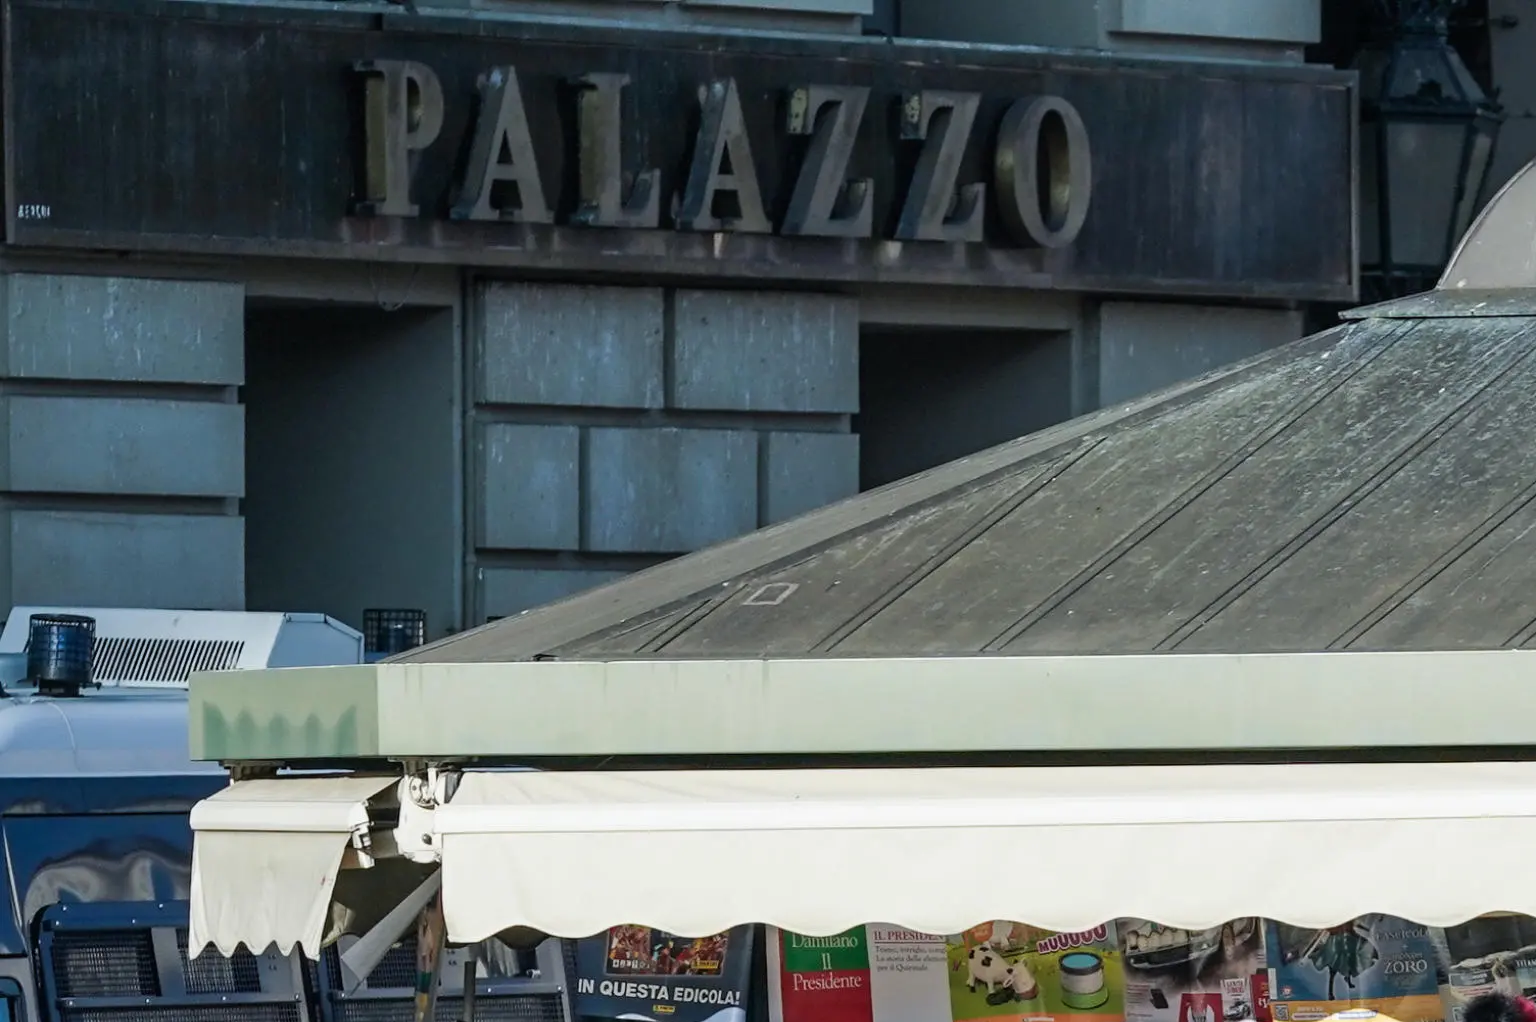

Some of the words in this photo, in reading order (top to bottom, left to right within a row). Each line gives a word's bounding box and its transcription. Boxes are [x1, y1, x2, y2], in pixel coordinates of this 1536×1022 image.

[355, 57, 1092, 249] PALAZZO
[578, 978, 595, 994] IN
[600, 980, 669, 1001] QUESTA
[673, 987, 741, 1006] EDICOLA!
[793, 973, 862, 991] Presidente
